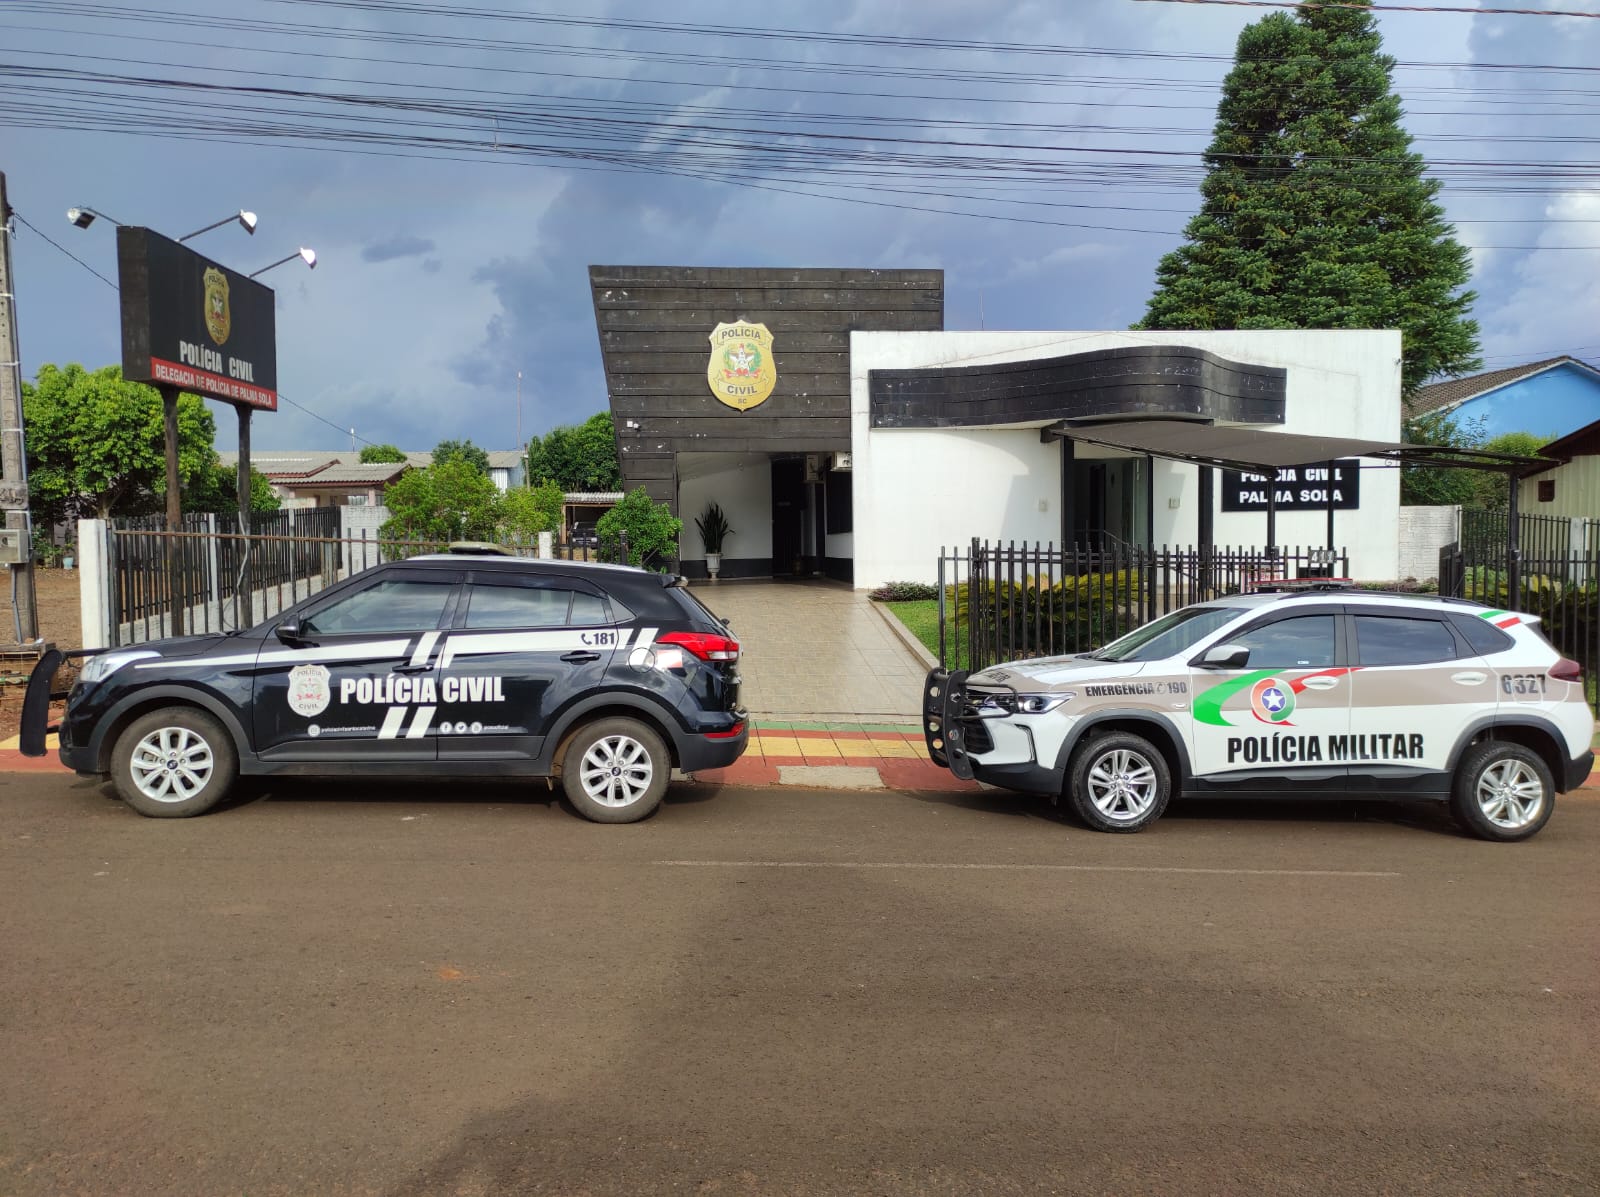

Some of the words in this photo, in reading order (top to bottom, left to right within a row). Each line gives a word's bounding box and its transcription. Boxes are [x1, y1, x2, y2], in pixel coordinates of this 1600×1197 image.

[179, 340, 223, 374] POLÍCIA
[228, 356, 254, 382] CIVIL
[155, 363, 195, 385] DELEGACIA
[196, 375, 205, 389] DE
[258, 391, 273, 406] SOLA
[727, 385, 758, 395] CIVIL
[1305, 468, 1343, 481] CIVL
[593, 632, 615, 645] 181
[340, 672, 437, 704] POLÍCIA
[442, 676, 506, 702] CIVIL
[1166, 681, 1188, 694] 190
[1501, 673, 1547, 694] 6327
[1227, 731, 1323, 764] POLÍCIA
[1328, 733, 1424, 761] MILITAR
